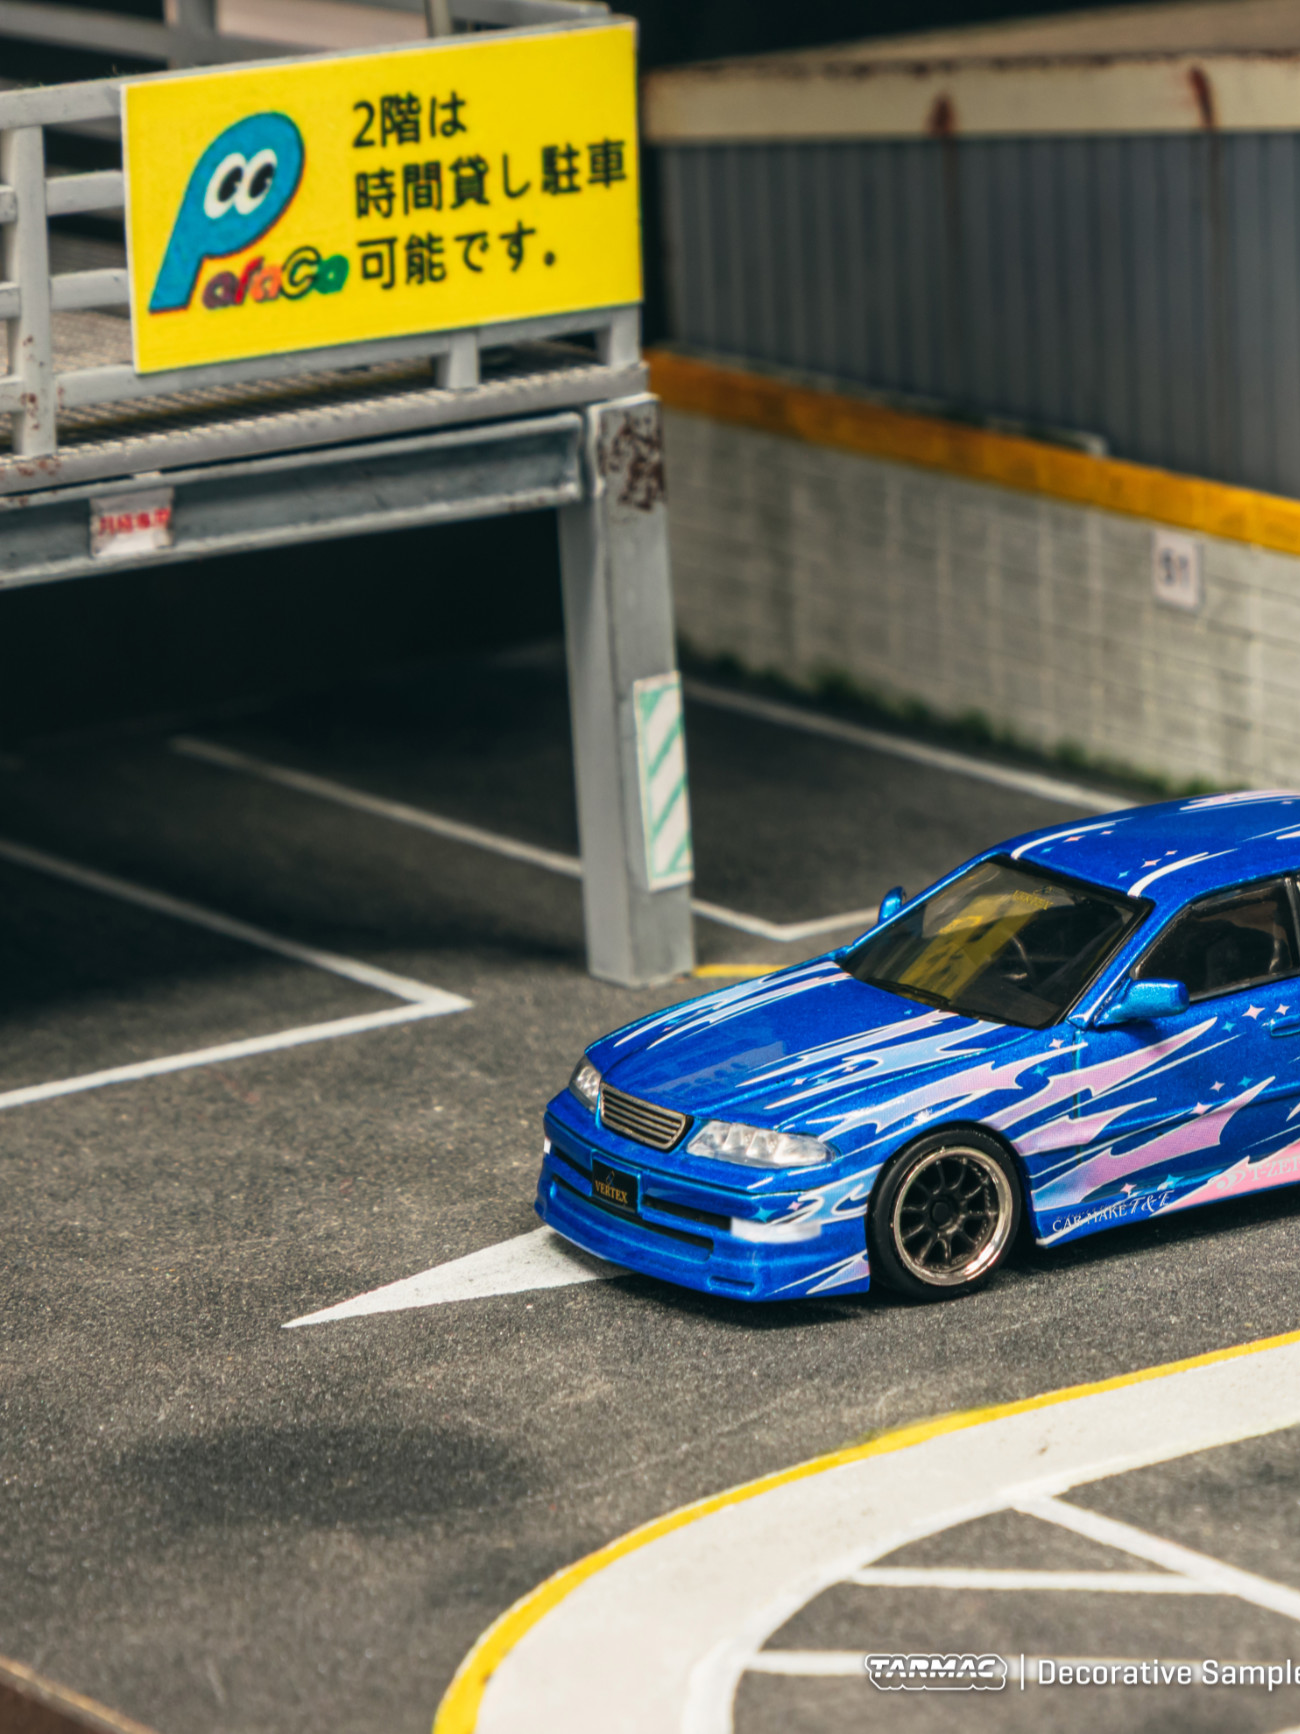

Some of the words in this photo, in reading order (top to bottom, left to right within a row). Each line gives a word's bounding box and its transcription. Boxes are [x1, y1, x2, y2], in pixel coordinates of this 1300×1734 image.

[352, 91, 467, 148] 2階は
[354, 137, 628, 219] 時間貸し駐車
[355, 219, 556, 290] 可能です。
[594, 1180, 629, 1204] VERTEX
[1052, 1213, 1083, 1233] CAR
[1085, 1204, 1128, 1225] MAKE
